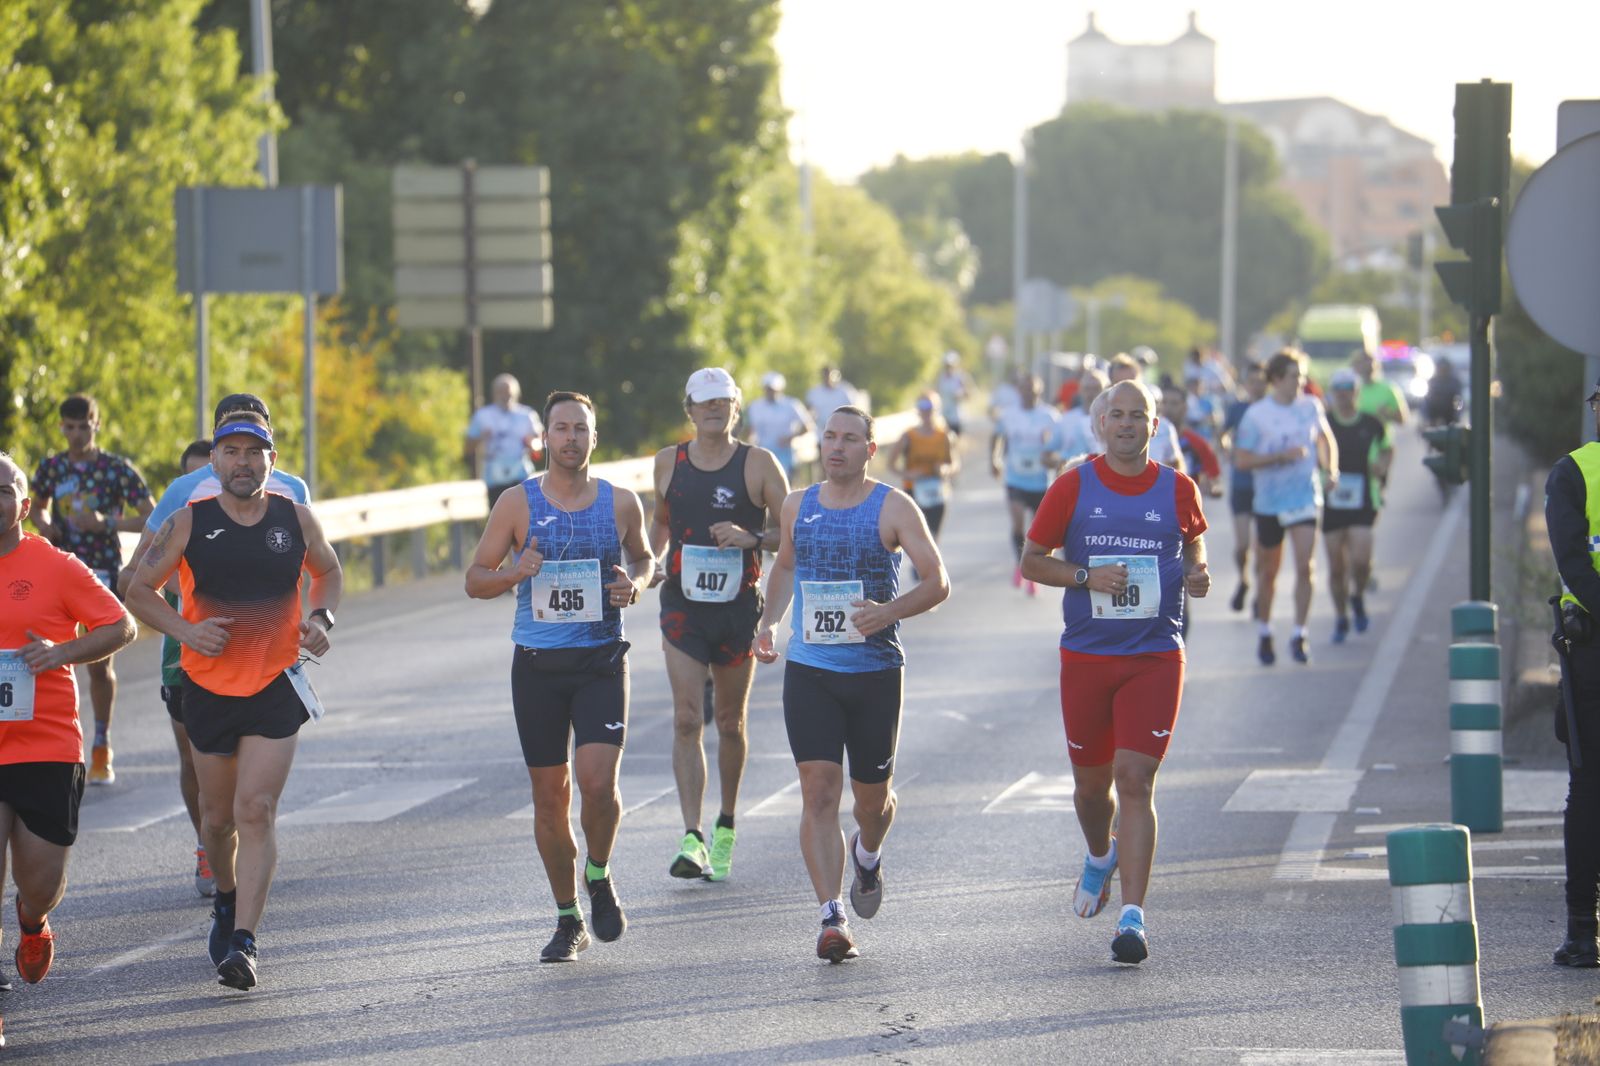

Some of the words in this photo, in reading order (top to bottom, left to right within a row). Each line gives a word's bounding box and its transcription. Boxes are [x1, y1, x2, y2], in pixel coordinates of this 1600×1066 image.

[1084, 534, 1163, 550] TROTASIERRA
[696, 572, 728, 592] 407
[549, 588, 585, 612] 435
[814, 610, 847, 633] 252
[0, 682, 13, 708] 6
